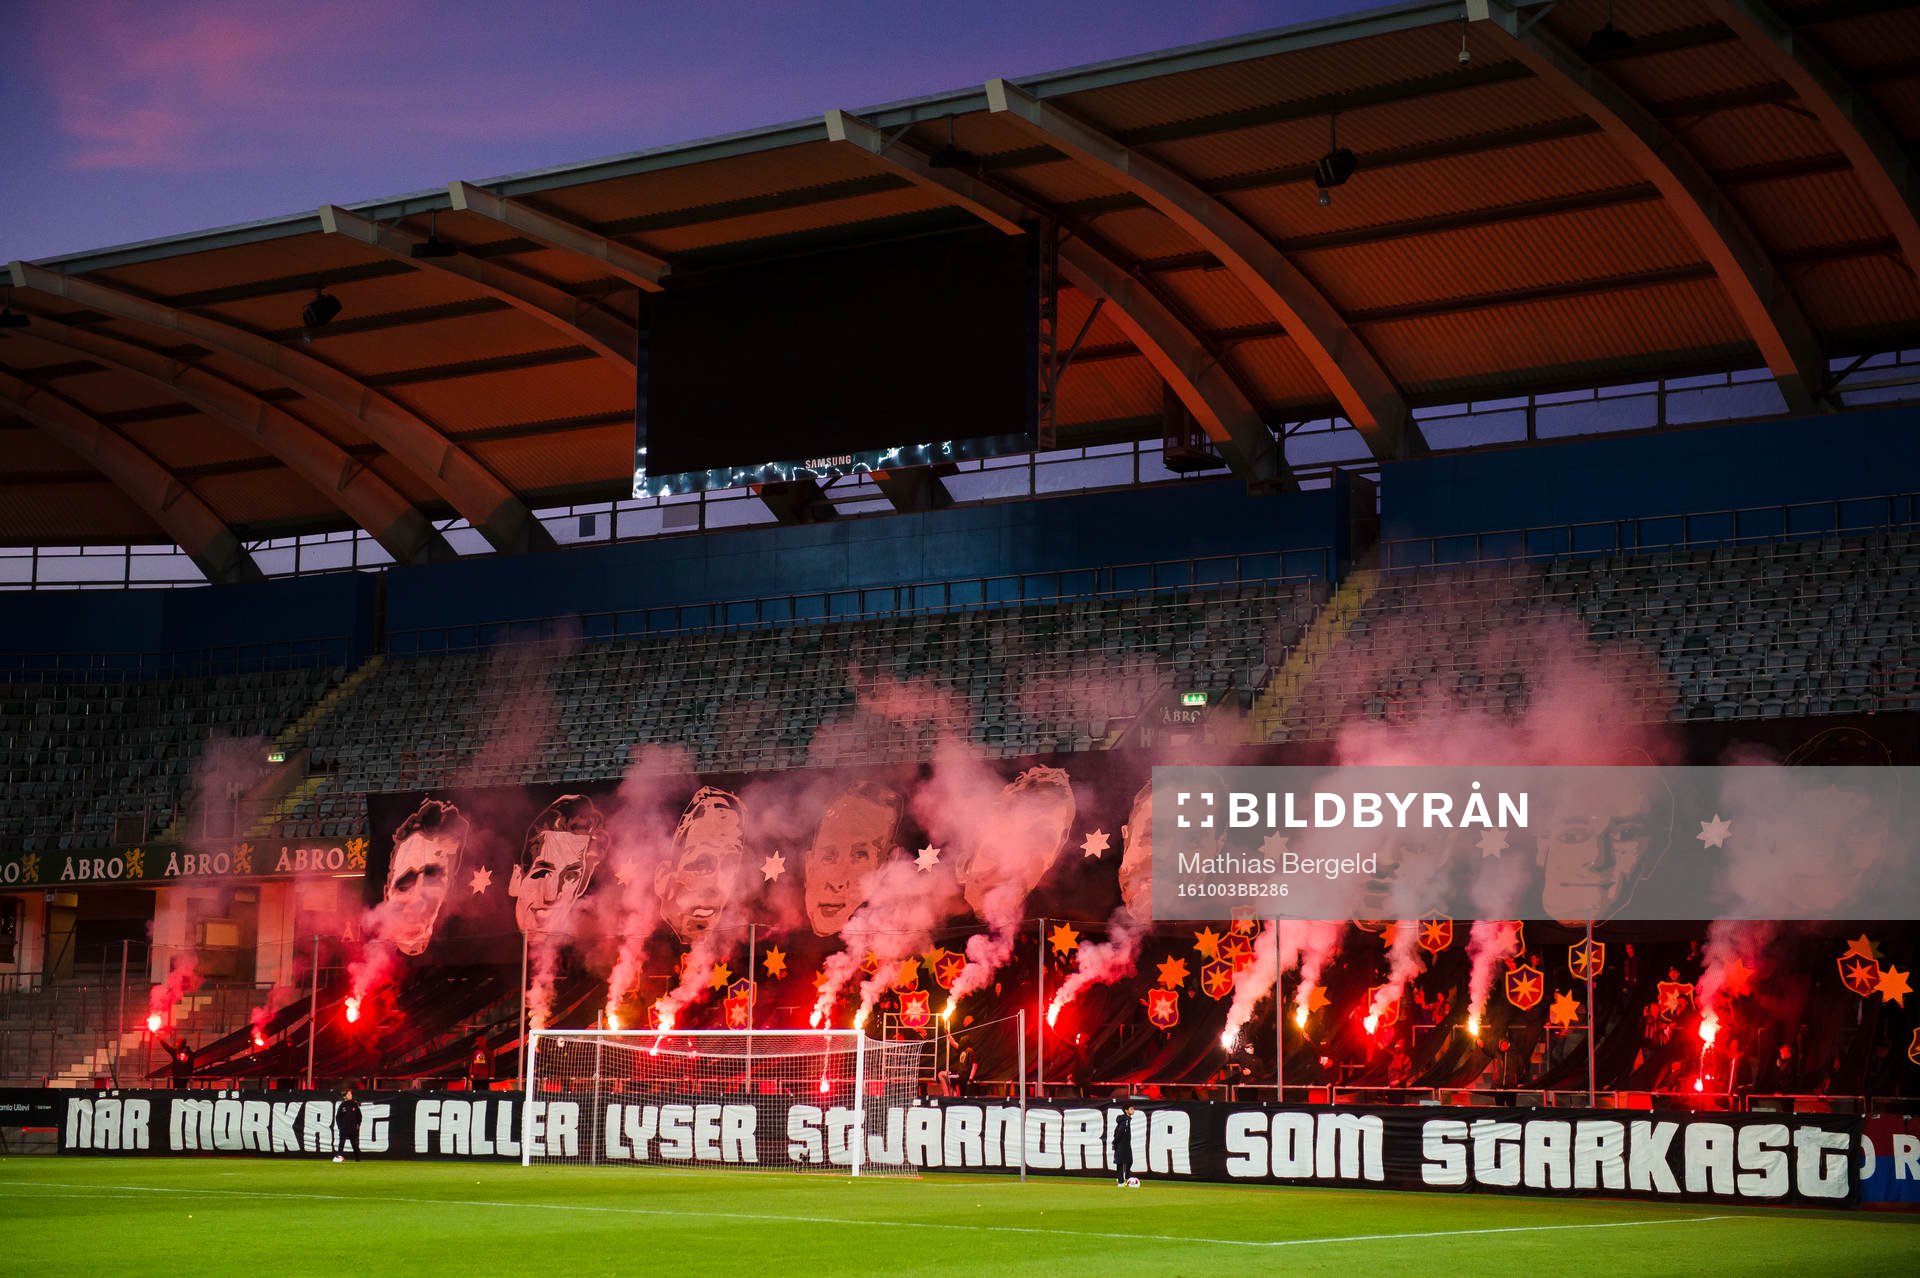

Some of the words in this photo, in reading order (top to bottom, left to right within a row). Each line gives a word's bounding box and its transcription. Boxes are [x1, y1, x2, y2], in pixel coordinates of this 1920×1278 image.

[805, 454, 852, 469] SAMSUNG
[60, 856, 124, 881] ÅBRO
[164, 851, 231, 876] ÅBRO
[275, 846, 345, 872] ÅBRO
[0, 862, 20, 883] O
[65, 1090, 151, 1150] NÄR
[414, 1099, 580, 1157] FALLER
[605, 1103, 759, 1163] LYSER
[1225, 1111, 1385, 1182] SOM
[1421, 1118, 1851, 1200] STARKAST
